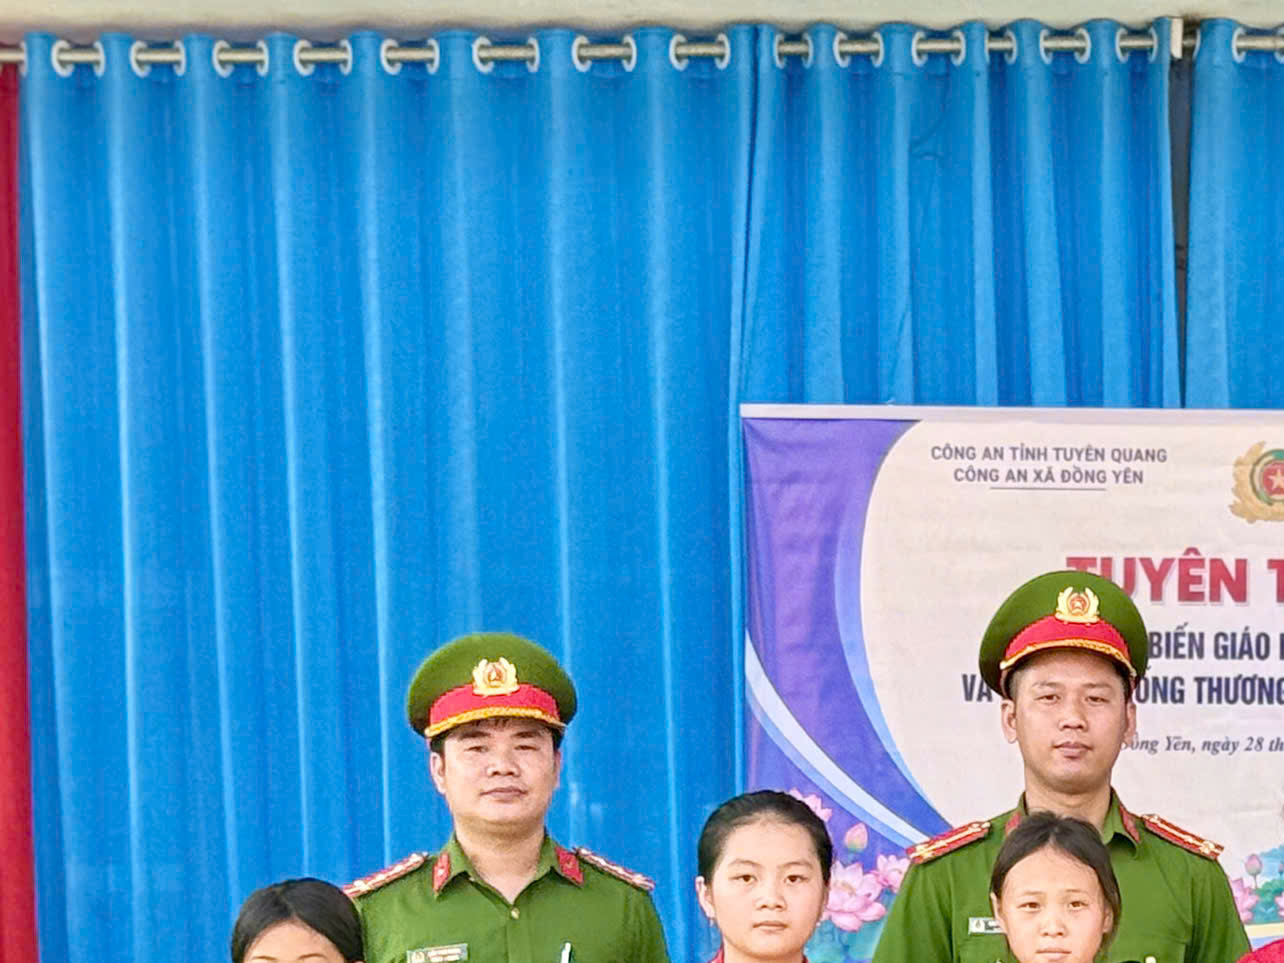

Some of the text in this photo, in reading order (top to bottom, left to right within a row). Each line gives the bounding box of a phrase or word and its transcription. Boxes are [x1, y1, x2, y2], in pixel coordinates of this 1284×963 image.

[931, 443, 1167, 463] CÔNG AN TỈNH TUYÊN QUANG
[954, 464, 1144, 484] CÔNG AN XÃ ĐỒNG YÊN
[1148, 622, 1204, 660] BIẾN
[1214, 626, 1271, 661] GIÁO
[1201, 736, 1240, 756] ngày
[1244, 737, 1263, 751] 28
